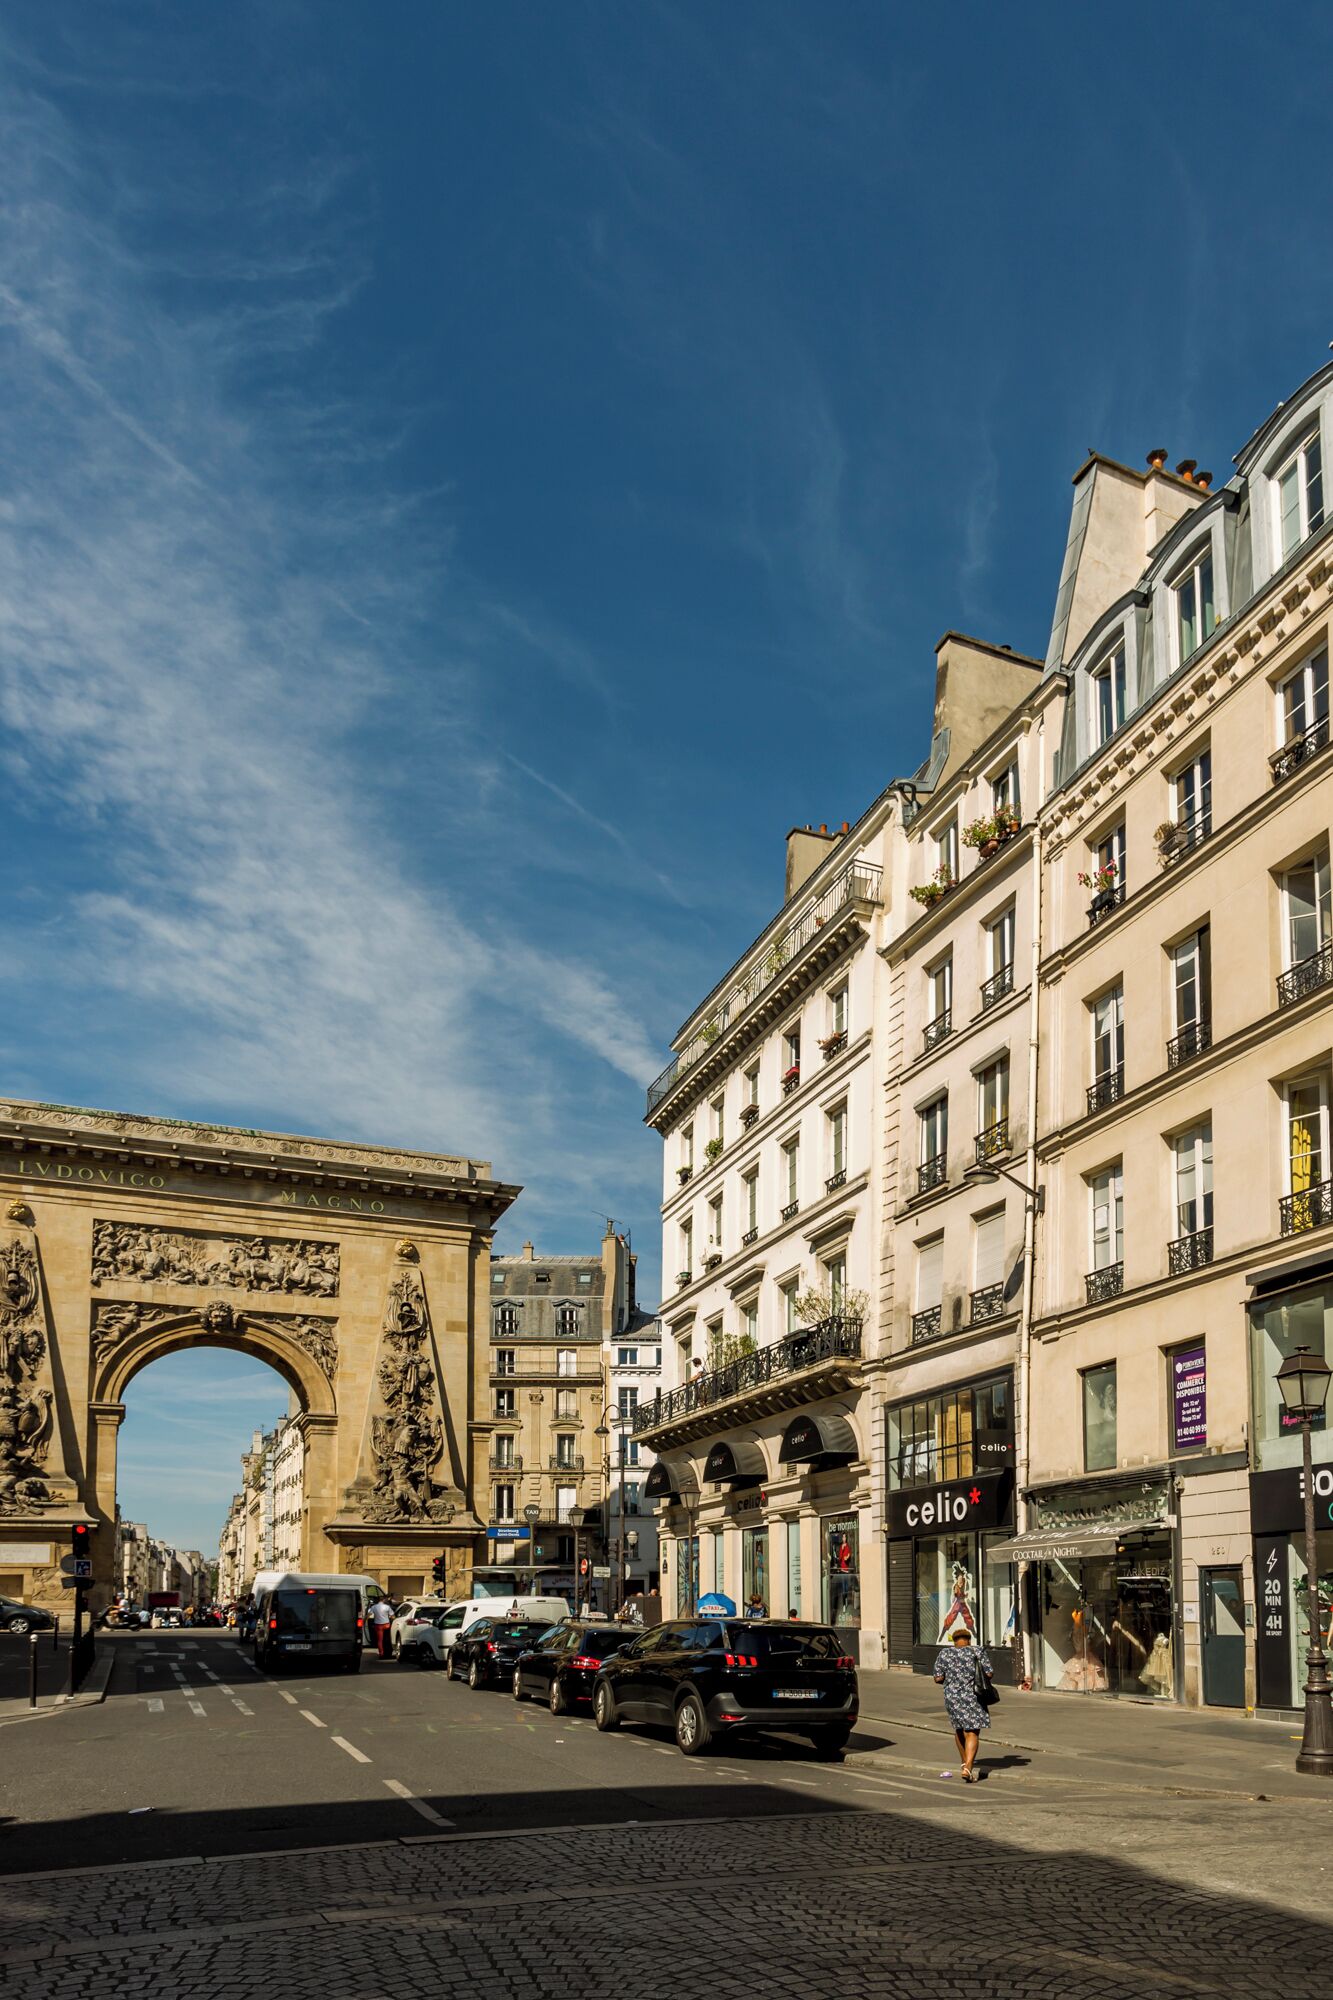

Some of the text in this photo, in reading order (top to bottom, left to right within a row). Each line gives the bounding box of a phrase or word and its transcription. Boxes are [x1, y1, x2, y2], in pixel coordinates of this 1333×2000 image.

[18, 1160, 384, 1213] LVDOVICO MAGNO
[1177, 1378, 1204, 1390] COMMERCE
[1175, 1385, 1206, 1399] DISPONIBLE
[980, 1443, 1007, 1453] celio
[906, 1491, 968, 1527] celio
[1012, 1549, 1044, 1561] COCKTAIL
[1052, 1546, 1076, 1559] NIGHT
[1264, 1579, 1281, 1595] 20
[1265, 1595, 1282, 1606] MIN
[1265, 1615, 1282, 1630] 4H
